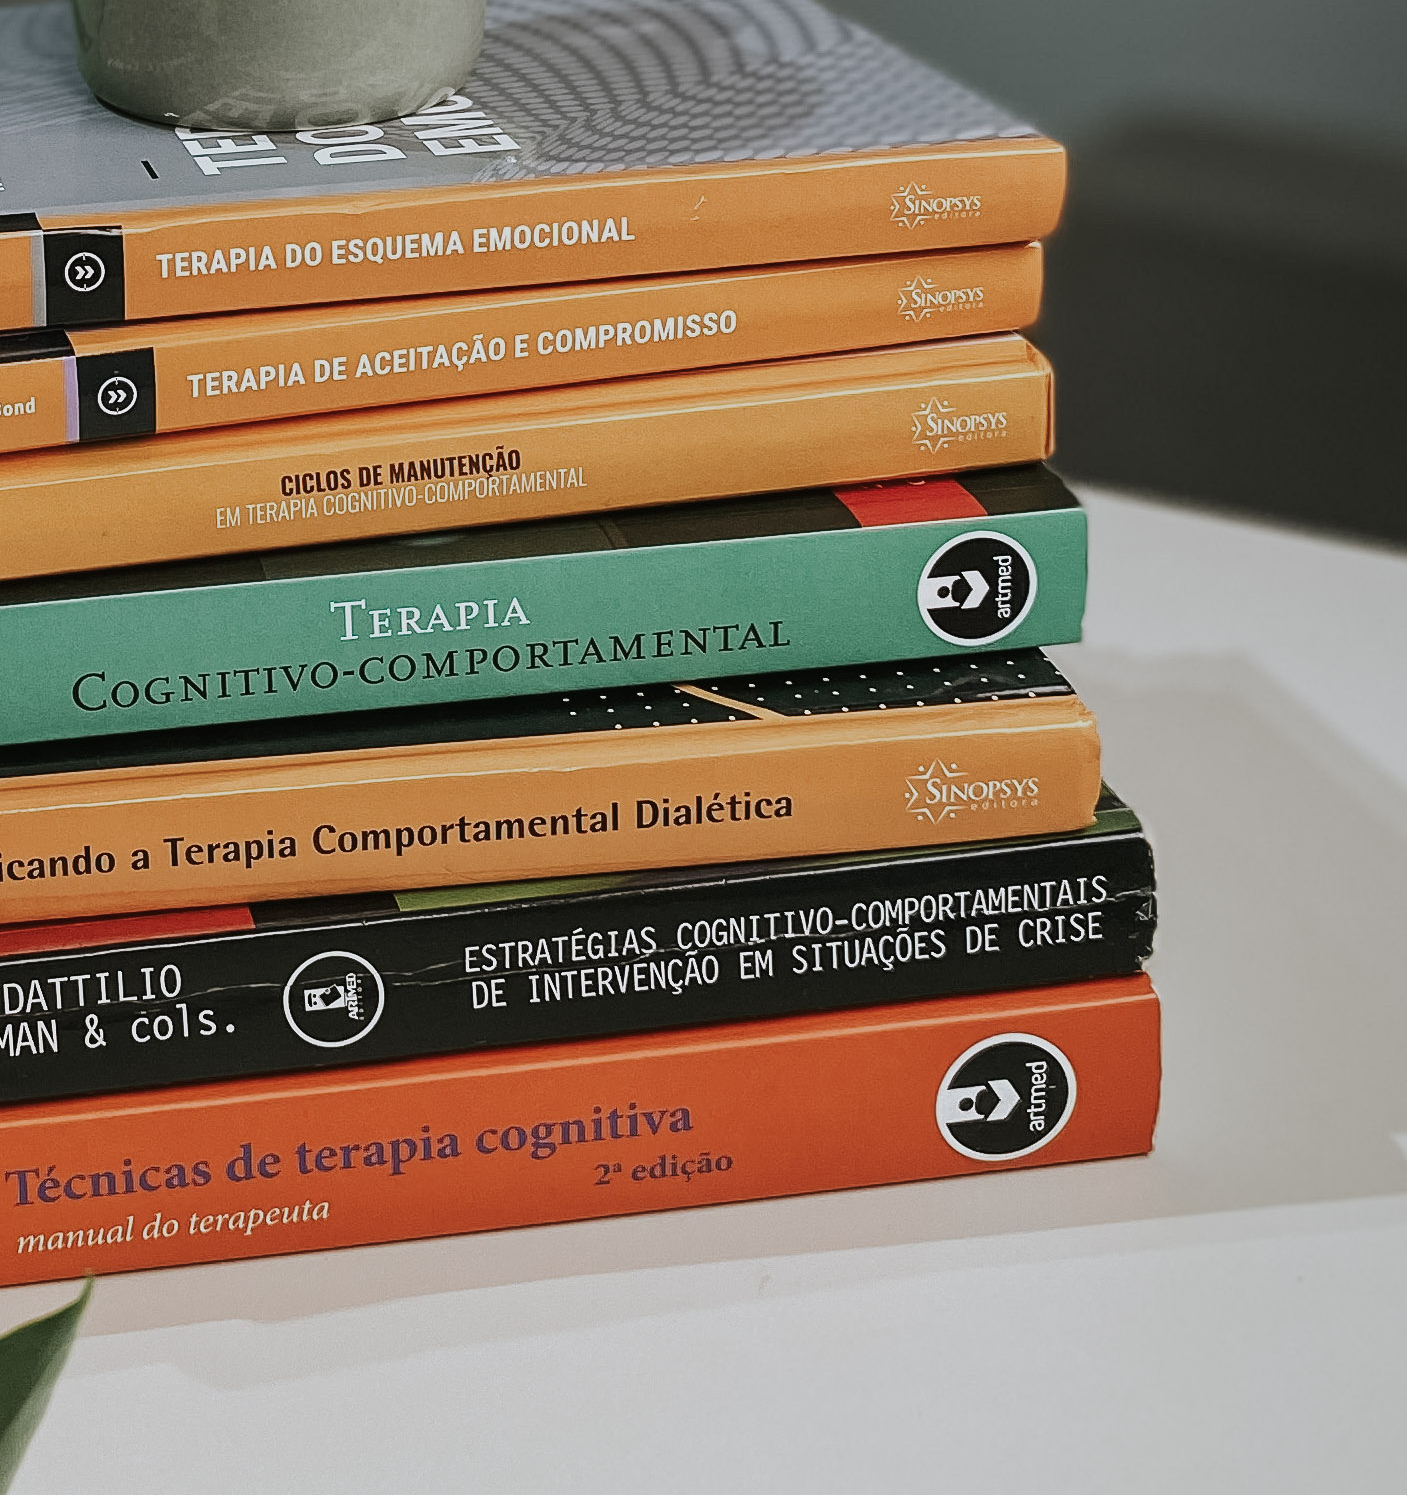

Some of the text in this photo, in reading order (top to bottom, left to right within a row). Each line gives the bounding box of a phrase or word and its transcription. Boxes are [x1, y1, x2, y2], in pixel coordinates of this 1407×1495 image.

[174, 126, 288, 176] TE
[295, 125, 407, 166] DO
[903, 195, 982, 214] SINOPSYS
[156, 216, 635, 279] TERAPIA DO ESQUEMA EMOCIONAL
[911, 287, 984, 308] SINOPSYS
[187, 309, 738, 398] TERAPIA DE ACEITAÇÃO E COMPROMISSO
[925, 411, 1008, 437] SINOPSYS
[216, 466, 588, 529] EM TERAPIA COGNITIVO-COMPORTAMENTAL
[280, 445, 522, 497] CICLOS DE MANUTENÇÃO
[992, 555, 1013, 619] artmed
[329, 595, 531, 643] TERAPIA
[71, 620, 792, 712] COGNITIVO-COMPORTAMENTAL
[925, 777, 1039, 804] SINOPSYS
[130, 846, 151, 871] a
[163, 829, 298, 869] Terapia
[312, 802, 619, 857] Comportamental
[636, 792, 793, 830] Dialética
[463, 875, 1108, 974] ESTRATÉGIAS COGNITIVO-COMPORTAMENTAIS
[471, 911, 1105, 1010] DE INTERVENÇÃO EM SITUAÇÕES DE CRISE
[2, 964, 183, 1016] DATTILIO
[84, 1013, 108, 1049] &
[131, 1004, 237, 1044] cols.
[1025, 1060, 1048, 1132] artmed
[4, 1102, 695, 1208] Técnicas de terapia cognitiva
[630, 1151, 735, 1185] edição
[15, 1199, 332, 1255] manual do terapeuta
